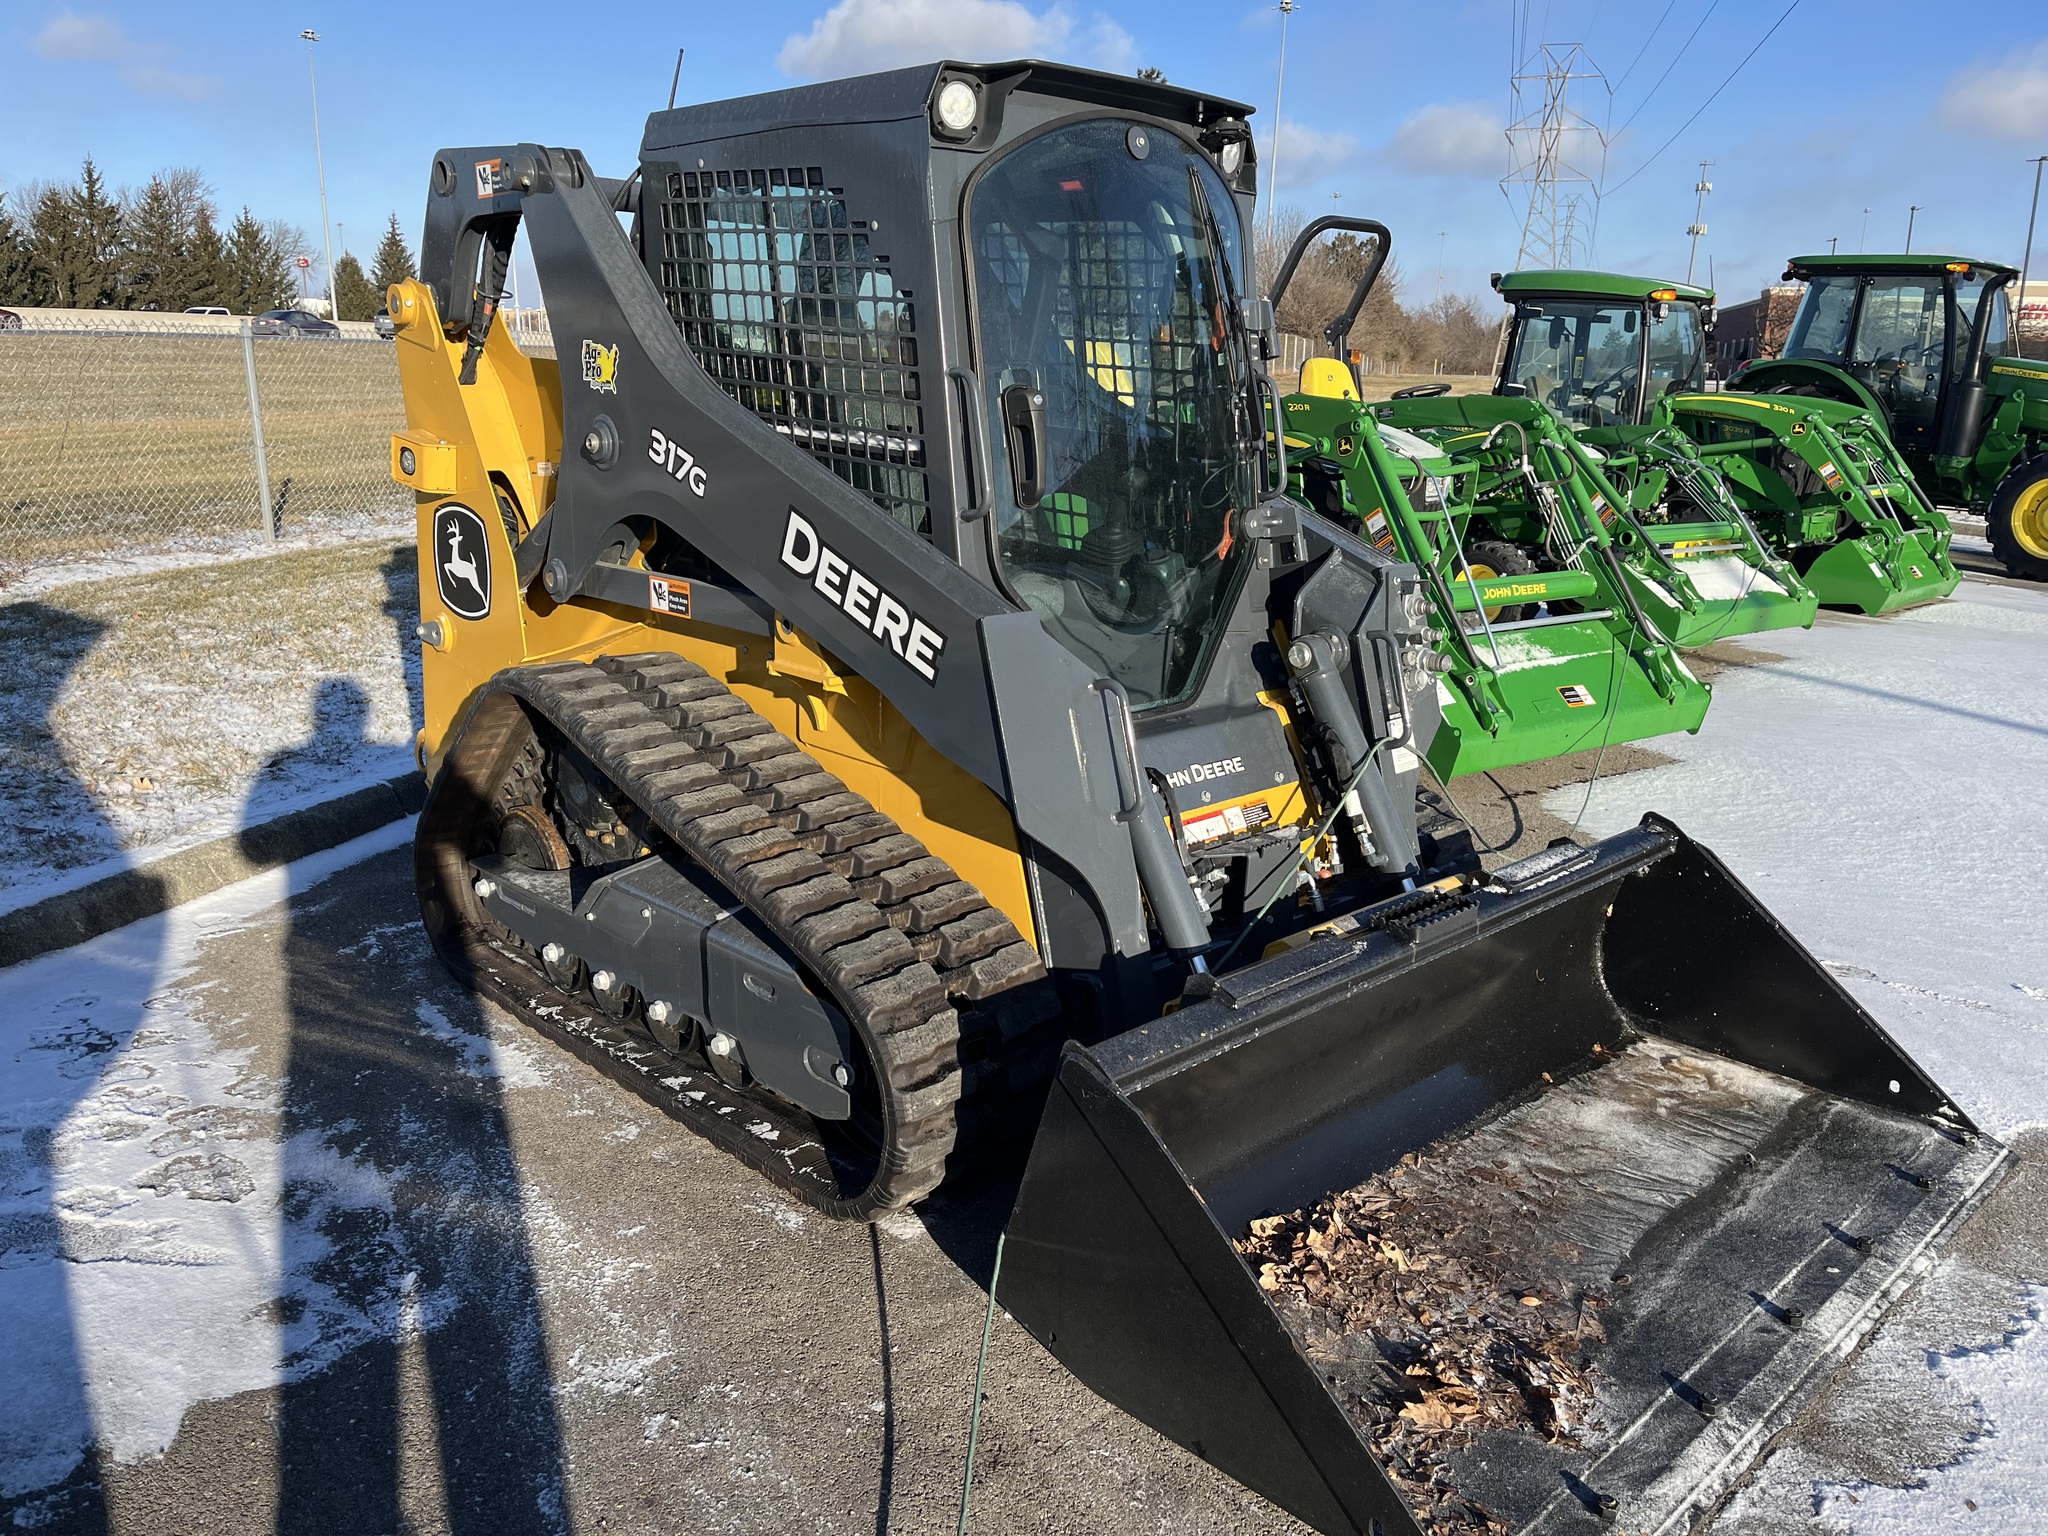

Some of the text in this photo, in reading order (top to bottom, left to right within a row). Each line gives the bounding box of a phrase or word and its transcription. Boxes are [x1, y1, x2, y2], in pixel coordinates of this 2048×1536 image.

[585, 361, 602, 378] Pro
[2017, 369, 2042, 378] DEERE
[1287, 403, 1304, 411] 220
[1772, 404, 1789, 413] 320
[1722, 424, 1744, 434] 3039
[648, 428, 707, 497] 317G
[781, 510, 944, 681] DEERE
[1483, 583, 1547, 600] JOHN DEERE
[1189, 756, 1245, 783] DEERE
